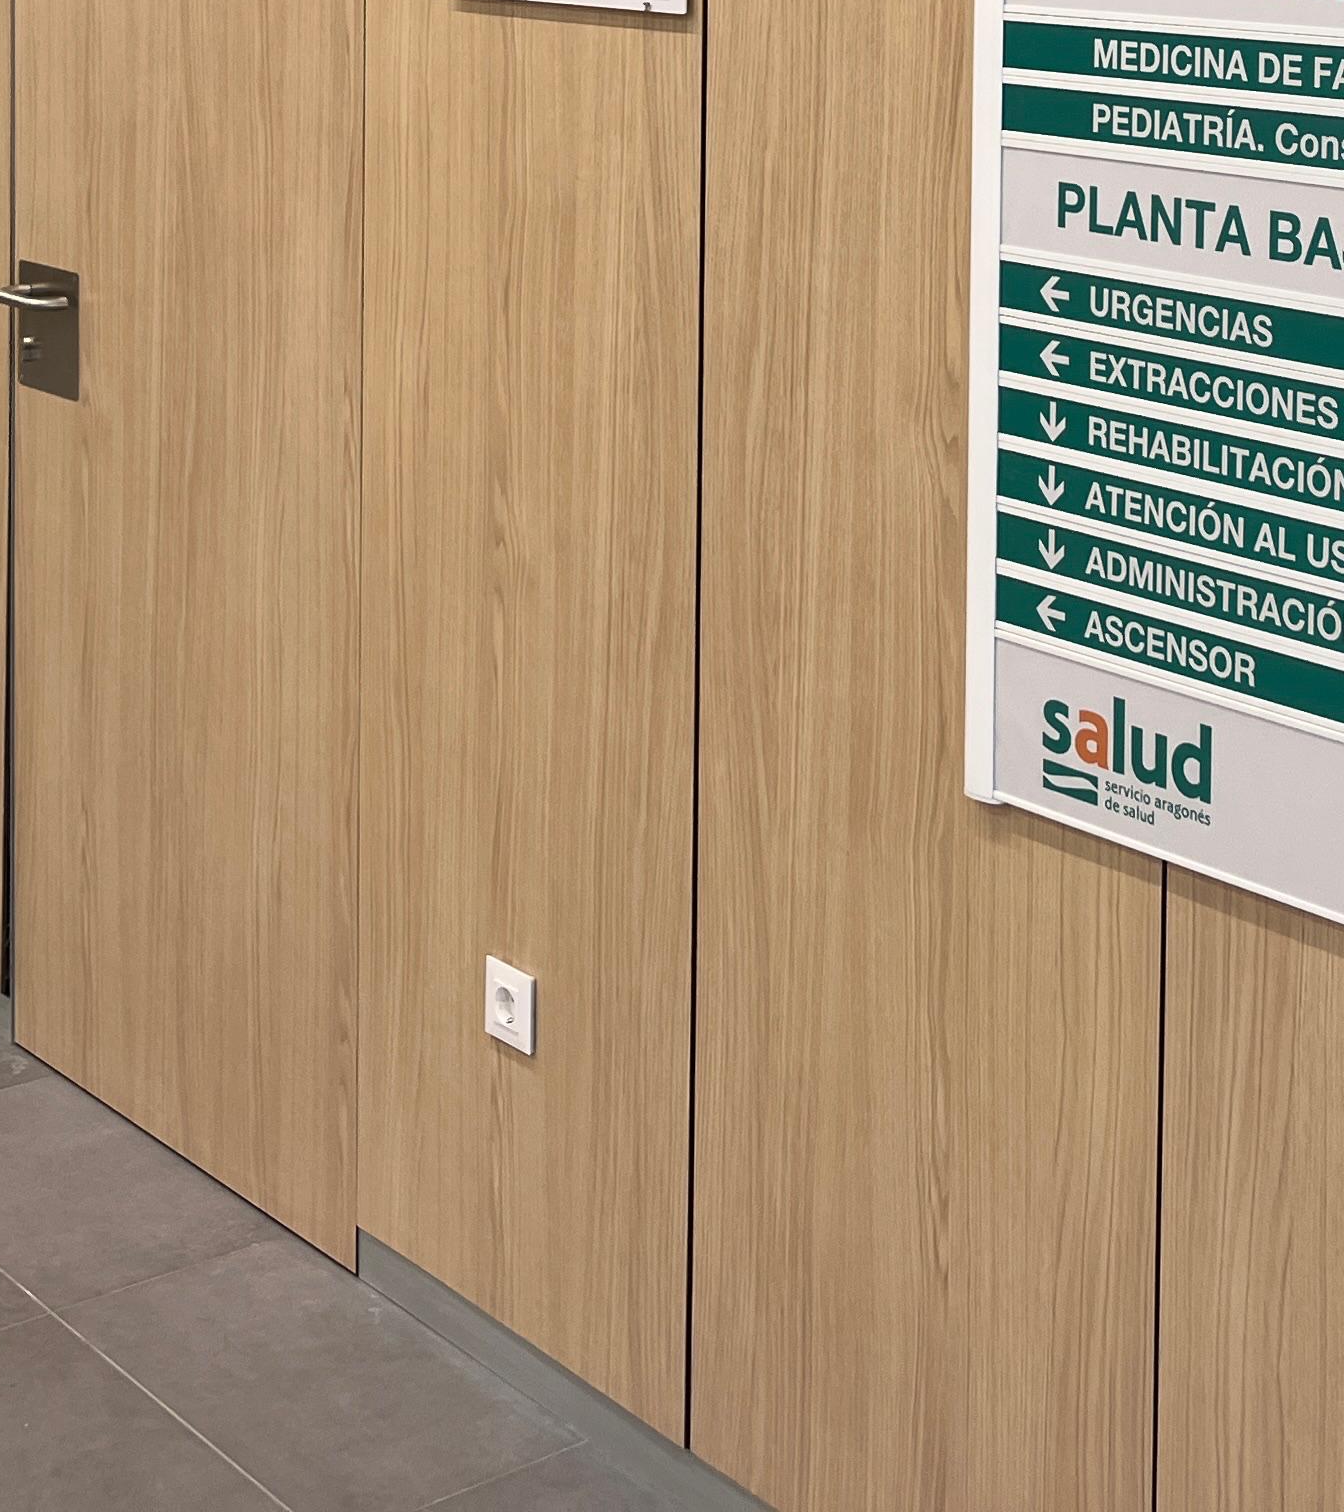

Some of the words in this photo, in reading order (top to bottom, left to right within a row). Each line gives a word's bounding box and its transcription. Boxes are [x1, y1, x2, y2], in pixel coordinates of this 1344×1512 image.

[1094, 39, 1248, 81] MEDICINA
[1259, 52, 1302, 86] DE
[1093, 104, 1263, 151] PEDIATRÍA.
[1058, 183, 1251, 257] PLANTA
[1091, 286, 1272, 347] URGENCIAS
[1090, 352, 1338, 429] EXTRACCIONES
[1085, 482, 1244, 547] ATENCIÓN
[1254, 523, 1295, 561] AL
[1085, 611, 1255, 686] ASCENSOR
[1042, 696, 1212, 803] salud
[1105, 781, 1150, 805] servicio
[1155, 798, 1210, 826] aragonés
[1105, 797, 1119, 813] de
[1123, 806, 1154, 825] salud
